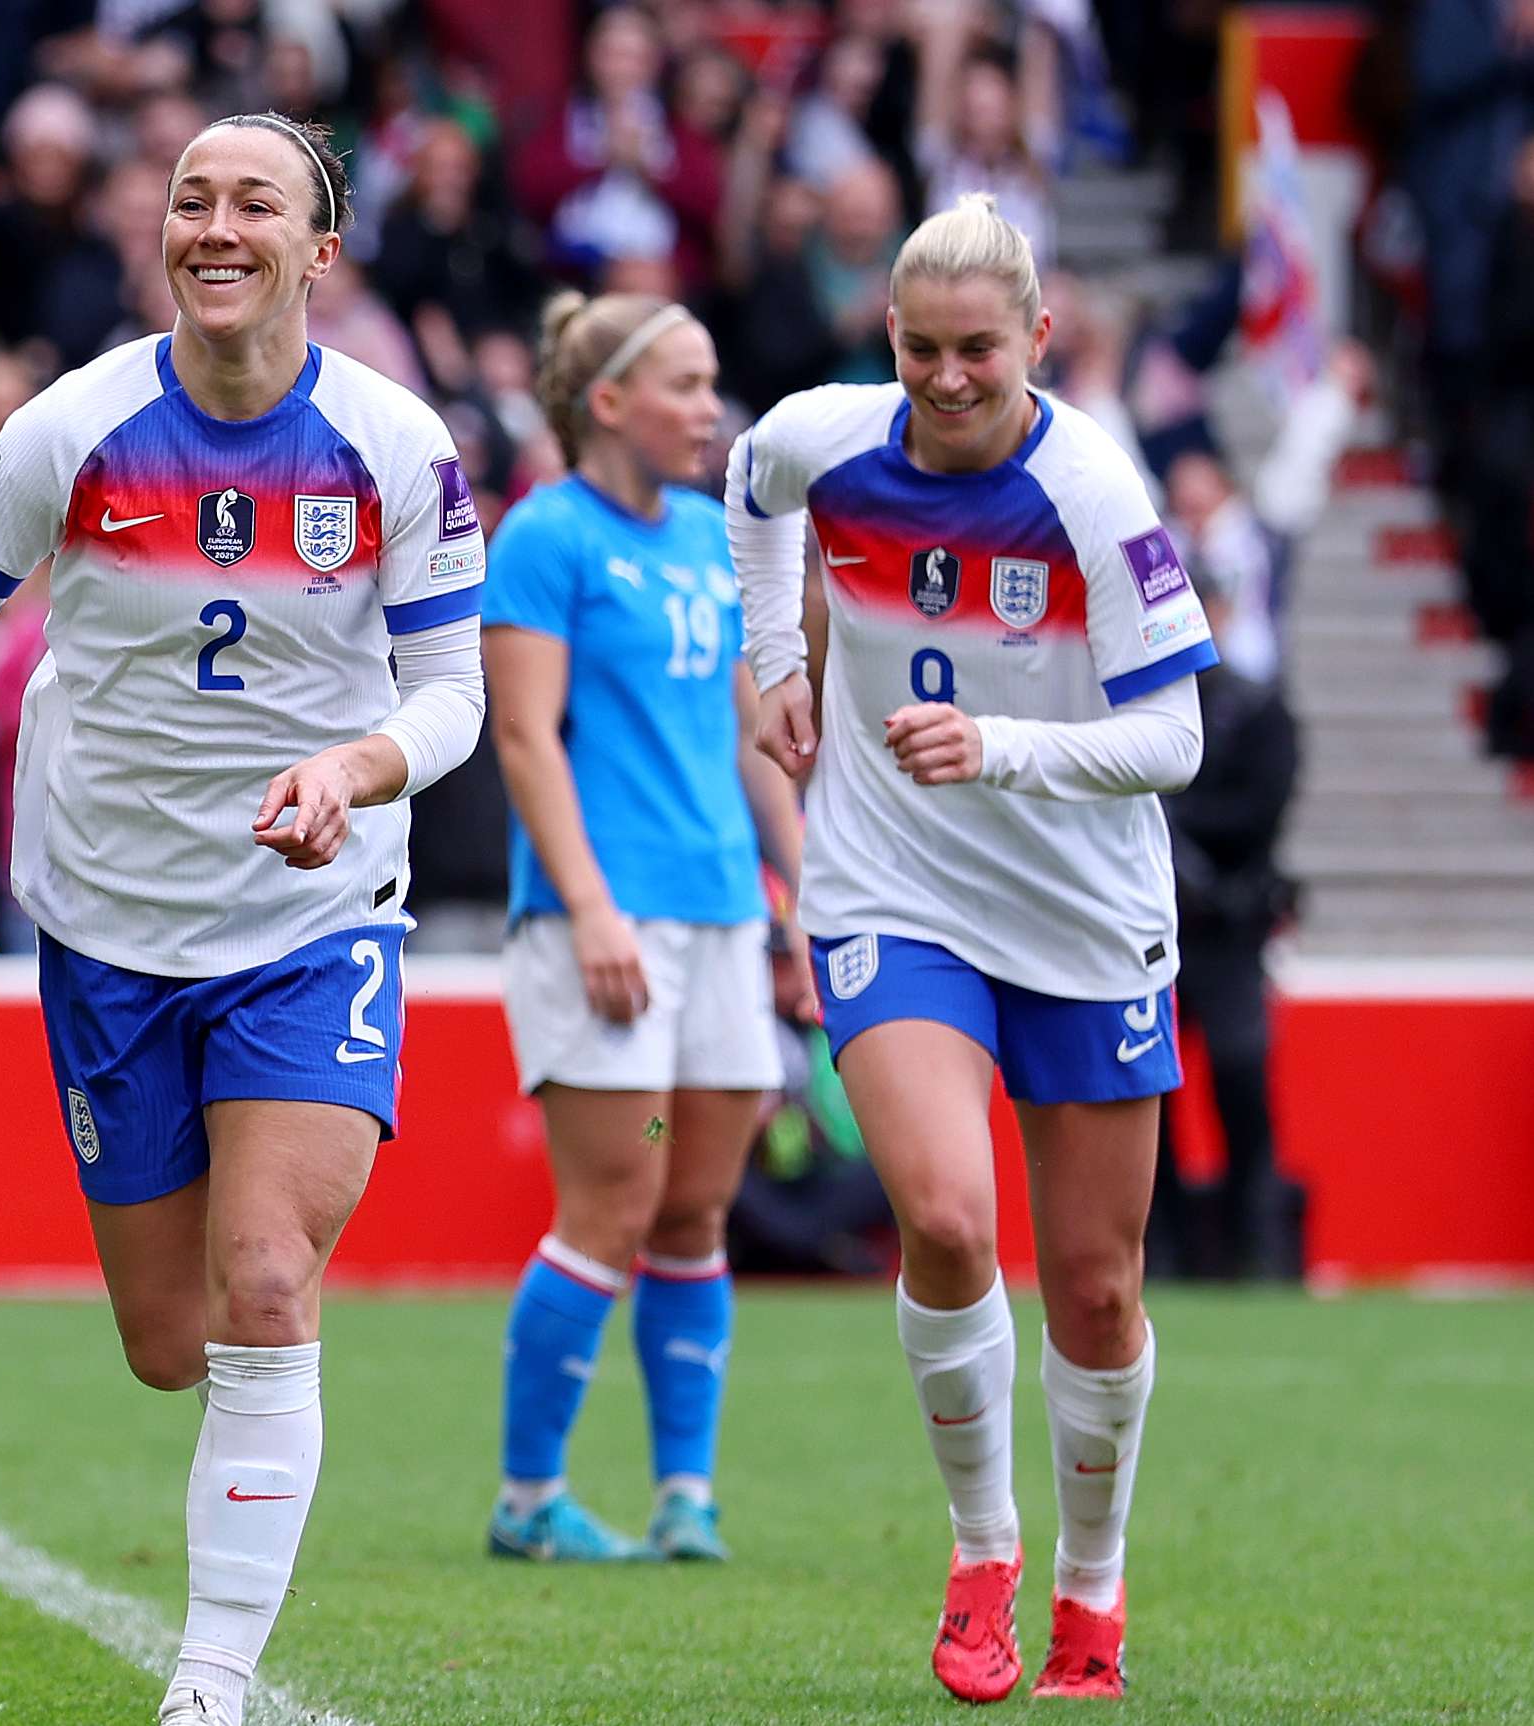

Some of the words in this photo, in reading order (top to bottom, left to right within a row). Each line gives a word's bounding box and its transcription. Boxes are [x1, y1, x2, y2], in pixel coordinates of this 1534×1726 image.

[205, 544, 244, 552] CHAMPIONS
[207, 537, 243, 545] EUROPEAN
[214, 552, 235, 560] 2025
[429, 552, 448, 561] UEFA
[430, 551, 484, 573] FOUNDAT
[663, 591, 721, 680] 19
[197, 599, 247, 690] 2
[351, 939, 386, 1048] 2
